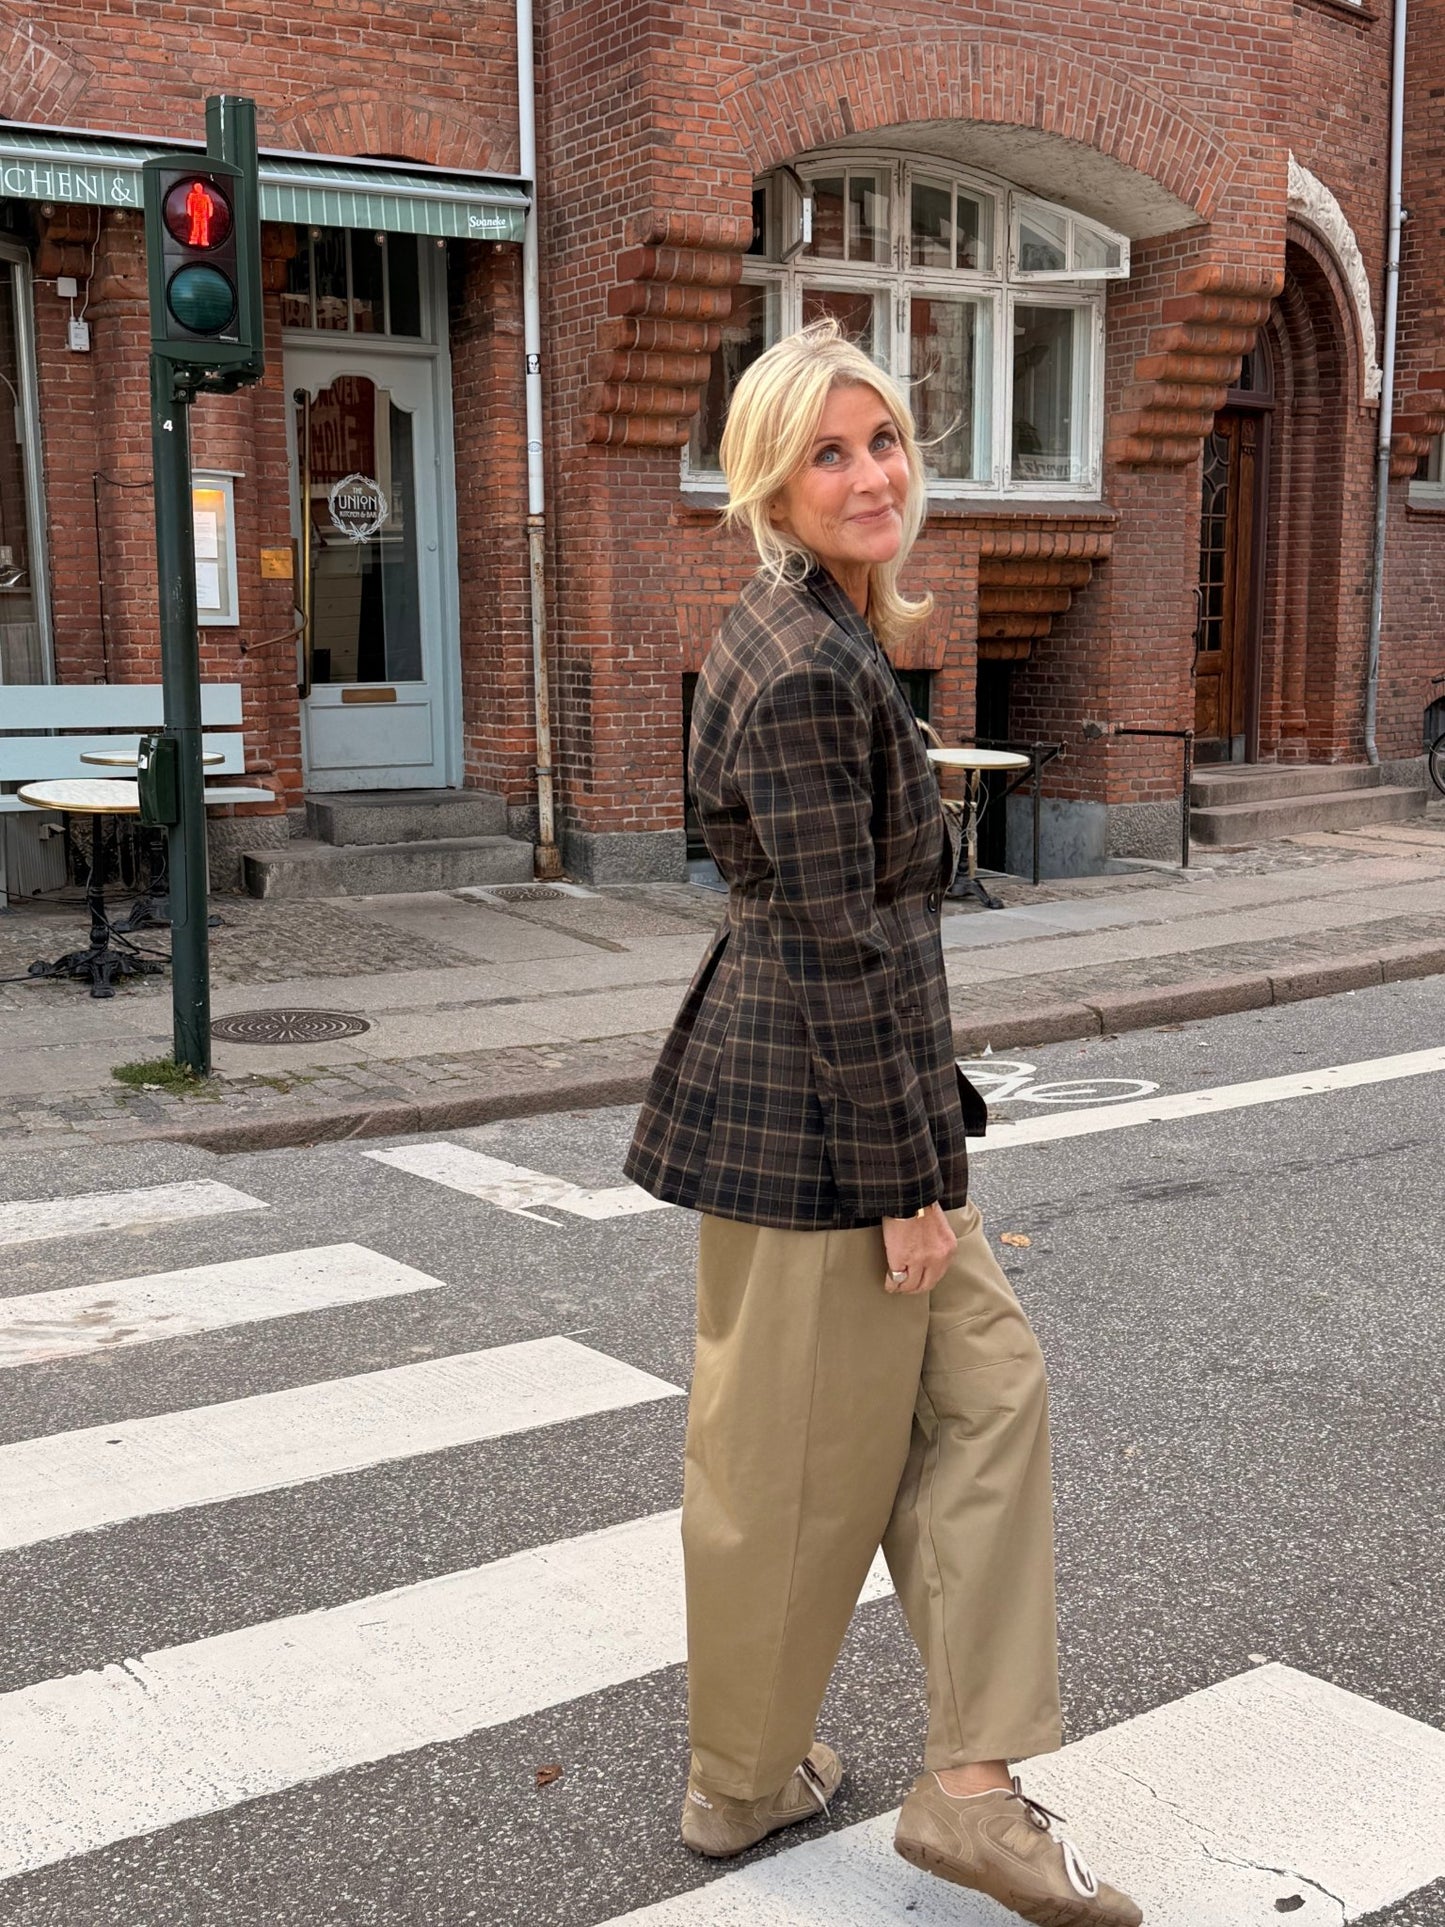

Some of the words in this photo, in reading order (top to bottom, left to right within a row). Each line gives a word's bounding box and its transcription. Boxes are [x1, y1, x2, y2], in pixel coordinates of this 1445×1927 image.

[0, 166, 98, 199] CHEN
[110, 178, 134, 202] &
[163, 420, 173, 431] 4
[338, 495, 377, 510] UNION
